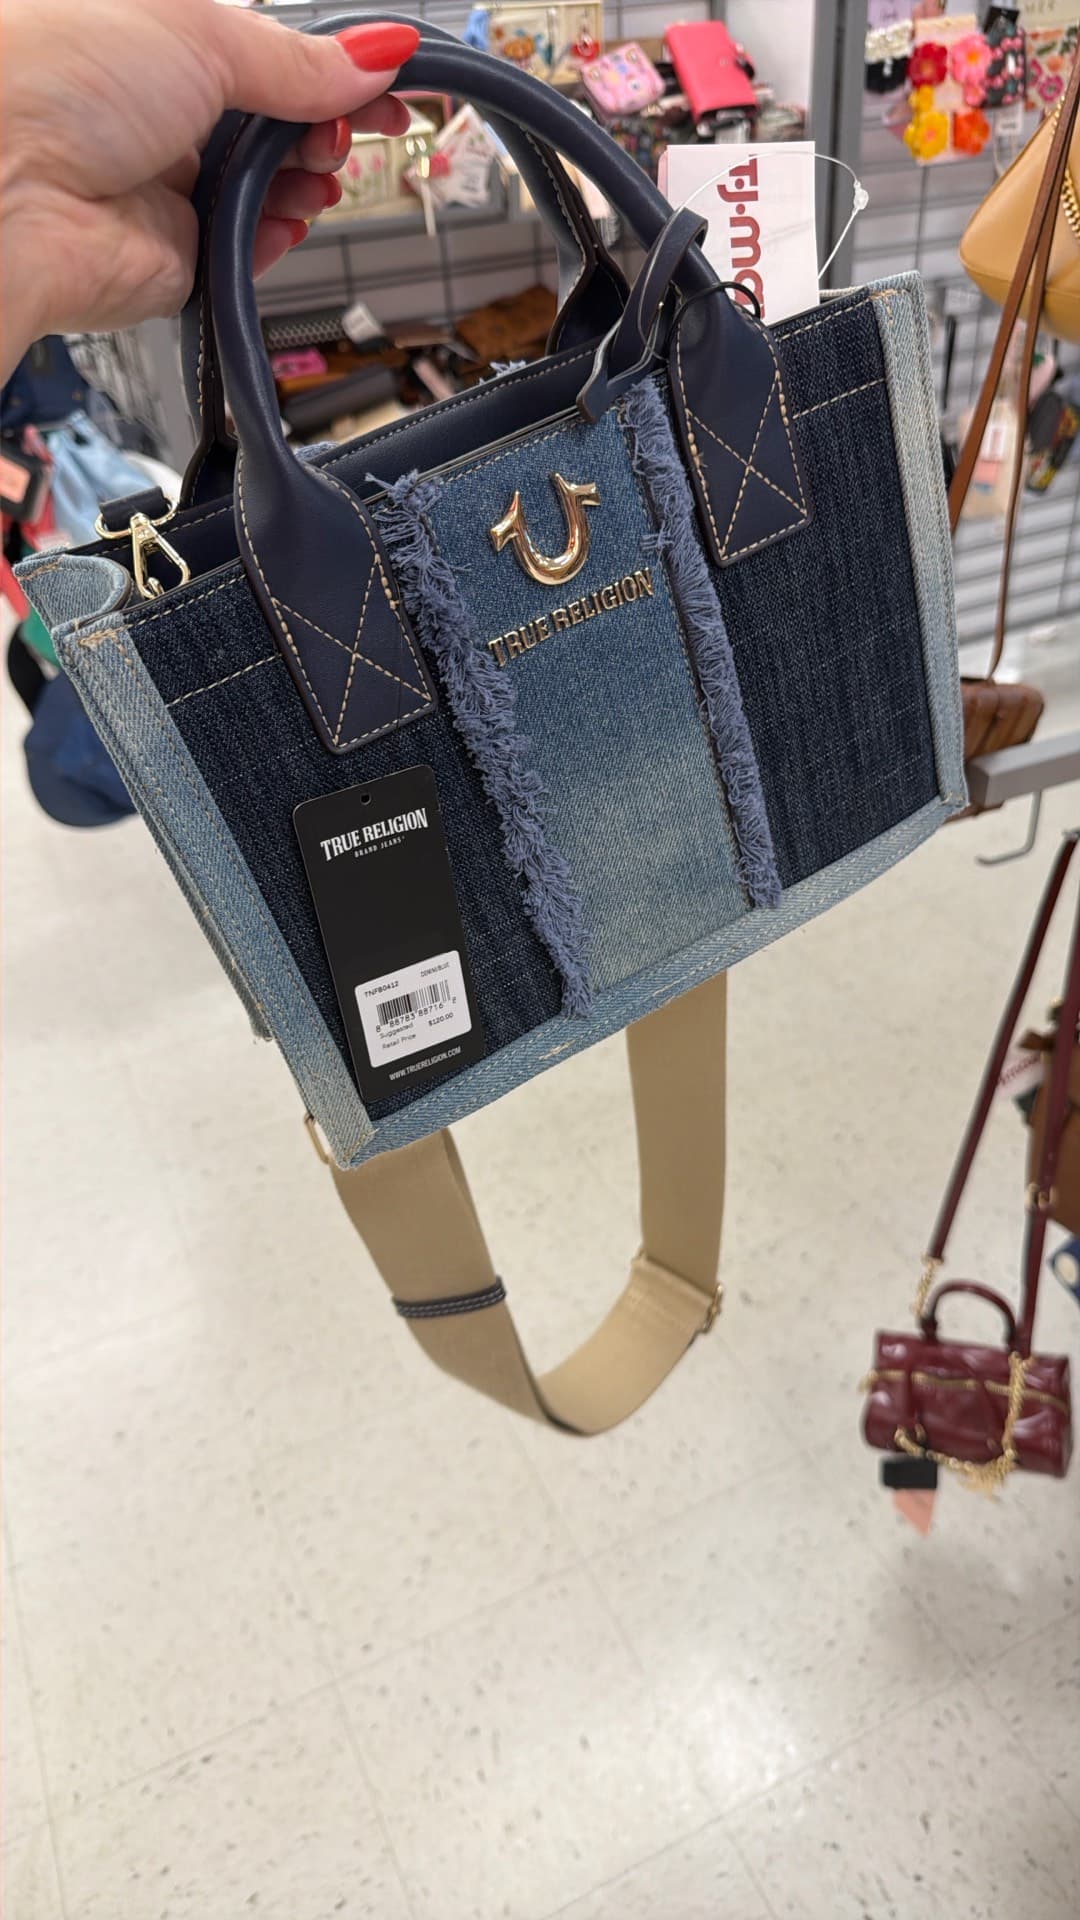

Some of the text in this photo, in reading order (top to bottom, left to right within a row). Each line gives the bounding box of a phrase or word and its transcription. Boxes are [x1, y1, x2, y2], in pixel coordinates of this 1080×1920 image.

[488, 567, 654, 667] TRUE RELIGION
[320, 807, 428, 861] TRUE RELIGION
[354, 845, 378, 858] BRAND
[428, 1012, 454, 1027] $120.00
[379, 1022, 414, 1039] Suggested
[382, 1033, 416, 1049] Retail Price
[389, 1046, 461, 1080] WWW.TRUERELIGION.COM
